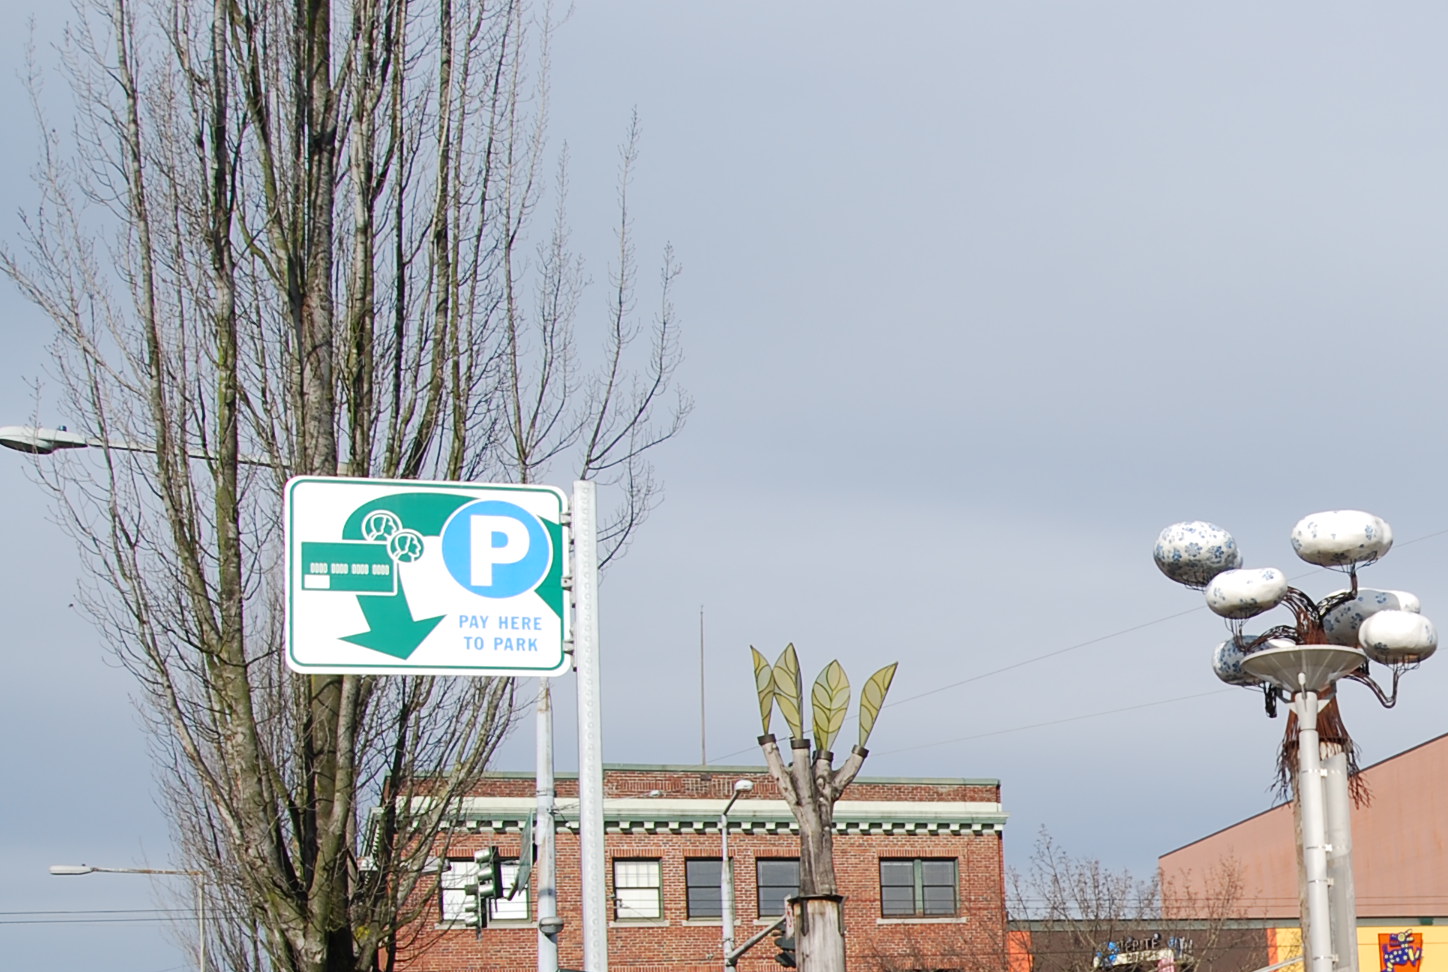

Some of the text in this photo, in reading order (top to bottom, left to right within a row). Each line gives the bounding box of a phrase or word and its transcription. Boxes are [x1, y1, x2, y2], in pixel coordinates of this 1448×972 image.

[470, 514, 530, 587] P
[458, 615, 543, 631] PAY HERE
[463, 636, 538, 652] TO PARK
